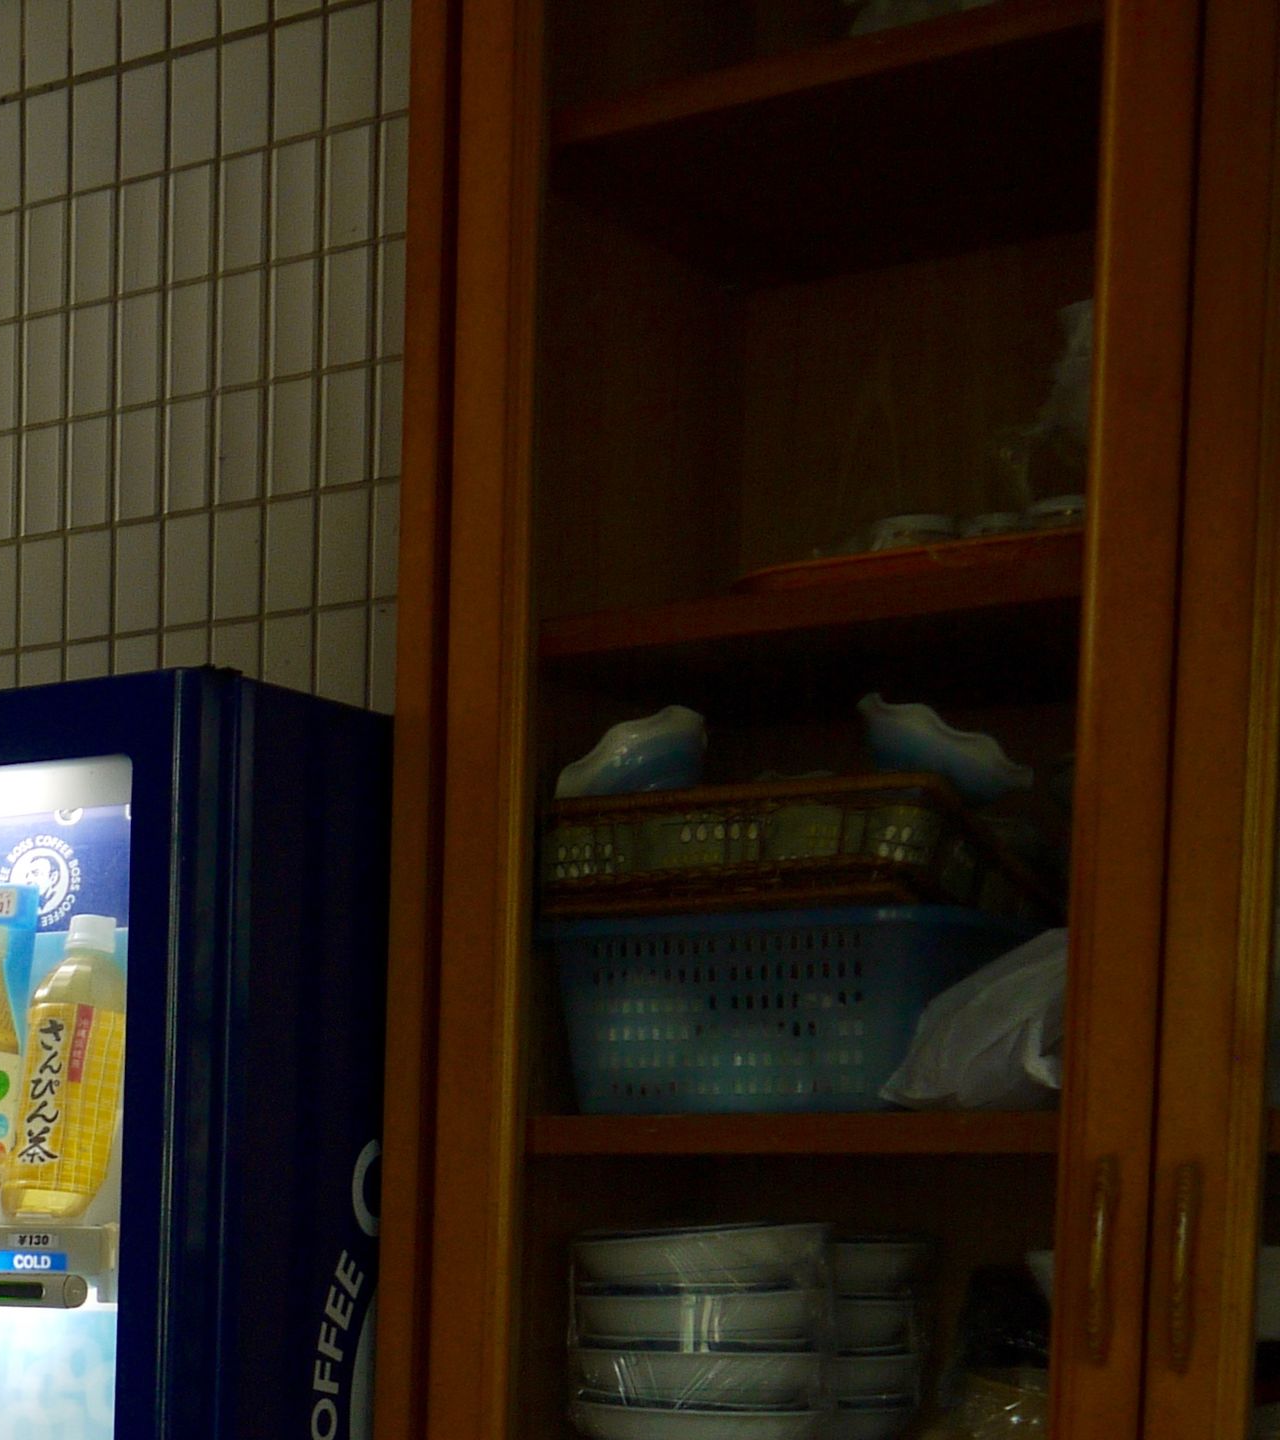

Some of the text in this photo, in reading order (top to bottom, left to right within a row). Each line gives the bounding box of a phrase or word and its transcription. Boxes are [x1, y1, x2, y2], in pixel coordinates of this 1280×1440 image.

[6, 834, 81, 928] BOSS COFFEE BOSS COFFEE
[18, 1019, 65, 1164] さんぴん茶
[12, 1253, 52, 1270] COLD
[17, 1233, 50, 1247] ¥130
